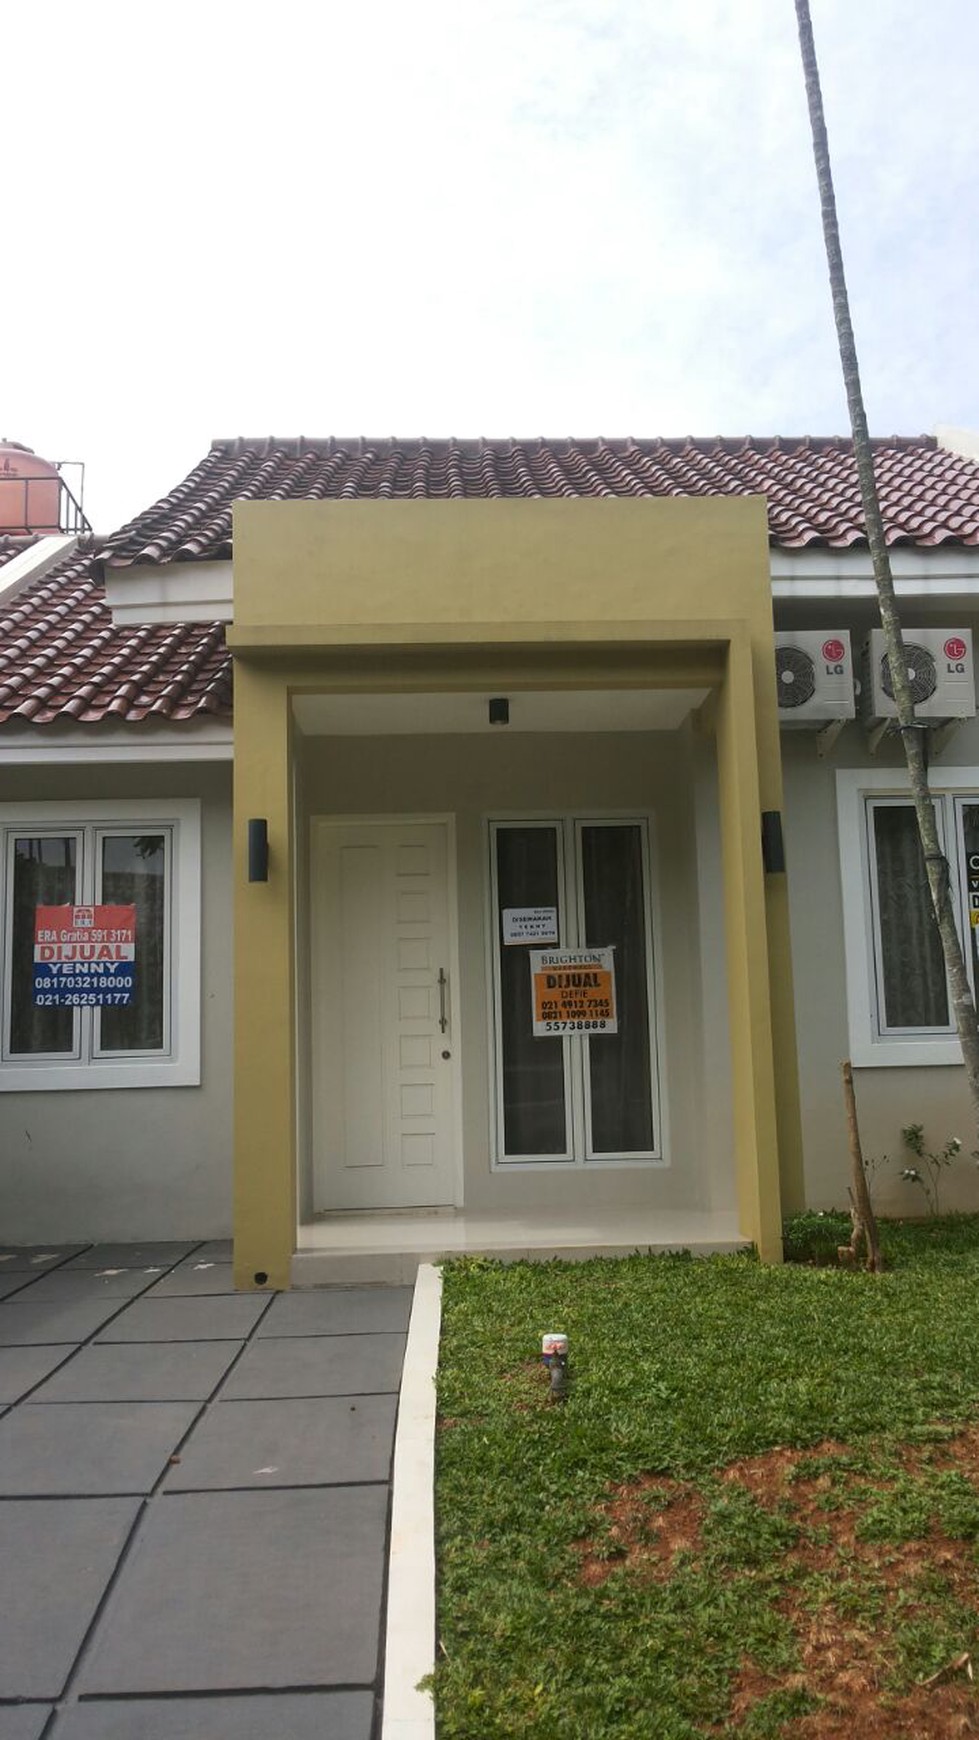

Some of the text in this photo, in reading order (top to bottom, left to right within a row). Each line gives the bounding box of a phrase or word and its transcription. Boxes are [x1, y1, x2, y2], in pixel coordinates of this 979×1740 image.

[825, 664, 844, 675] LG
[947, 663, 965, 674] LG
[37, 929, 132, 942] ERA Gratia 591 3171
[39, 945, 129, 960] DIJUAL
[541, 954, 602, 965] BRIGHTON
[48, 963, 119, 974] YENNY
[35, 977, 132, 989] 081703218000
[547, 973, 601, 989] DIJUAL
[35, 993, 130, 1006] 021-26251177
[561, 990, 588, 998] DEFIE
[541, 1001, 558, 1010] 021
[589, 1008, 610, 1018] 1145
[545, 1020, 606, 1031] 55738888
